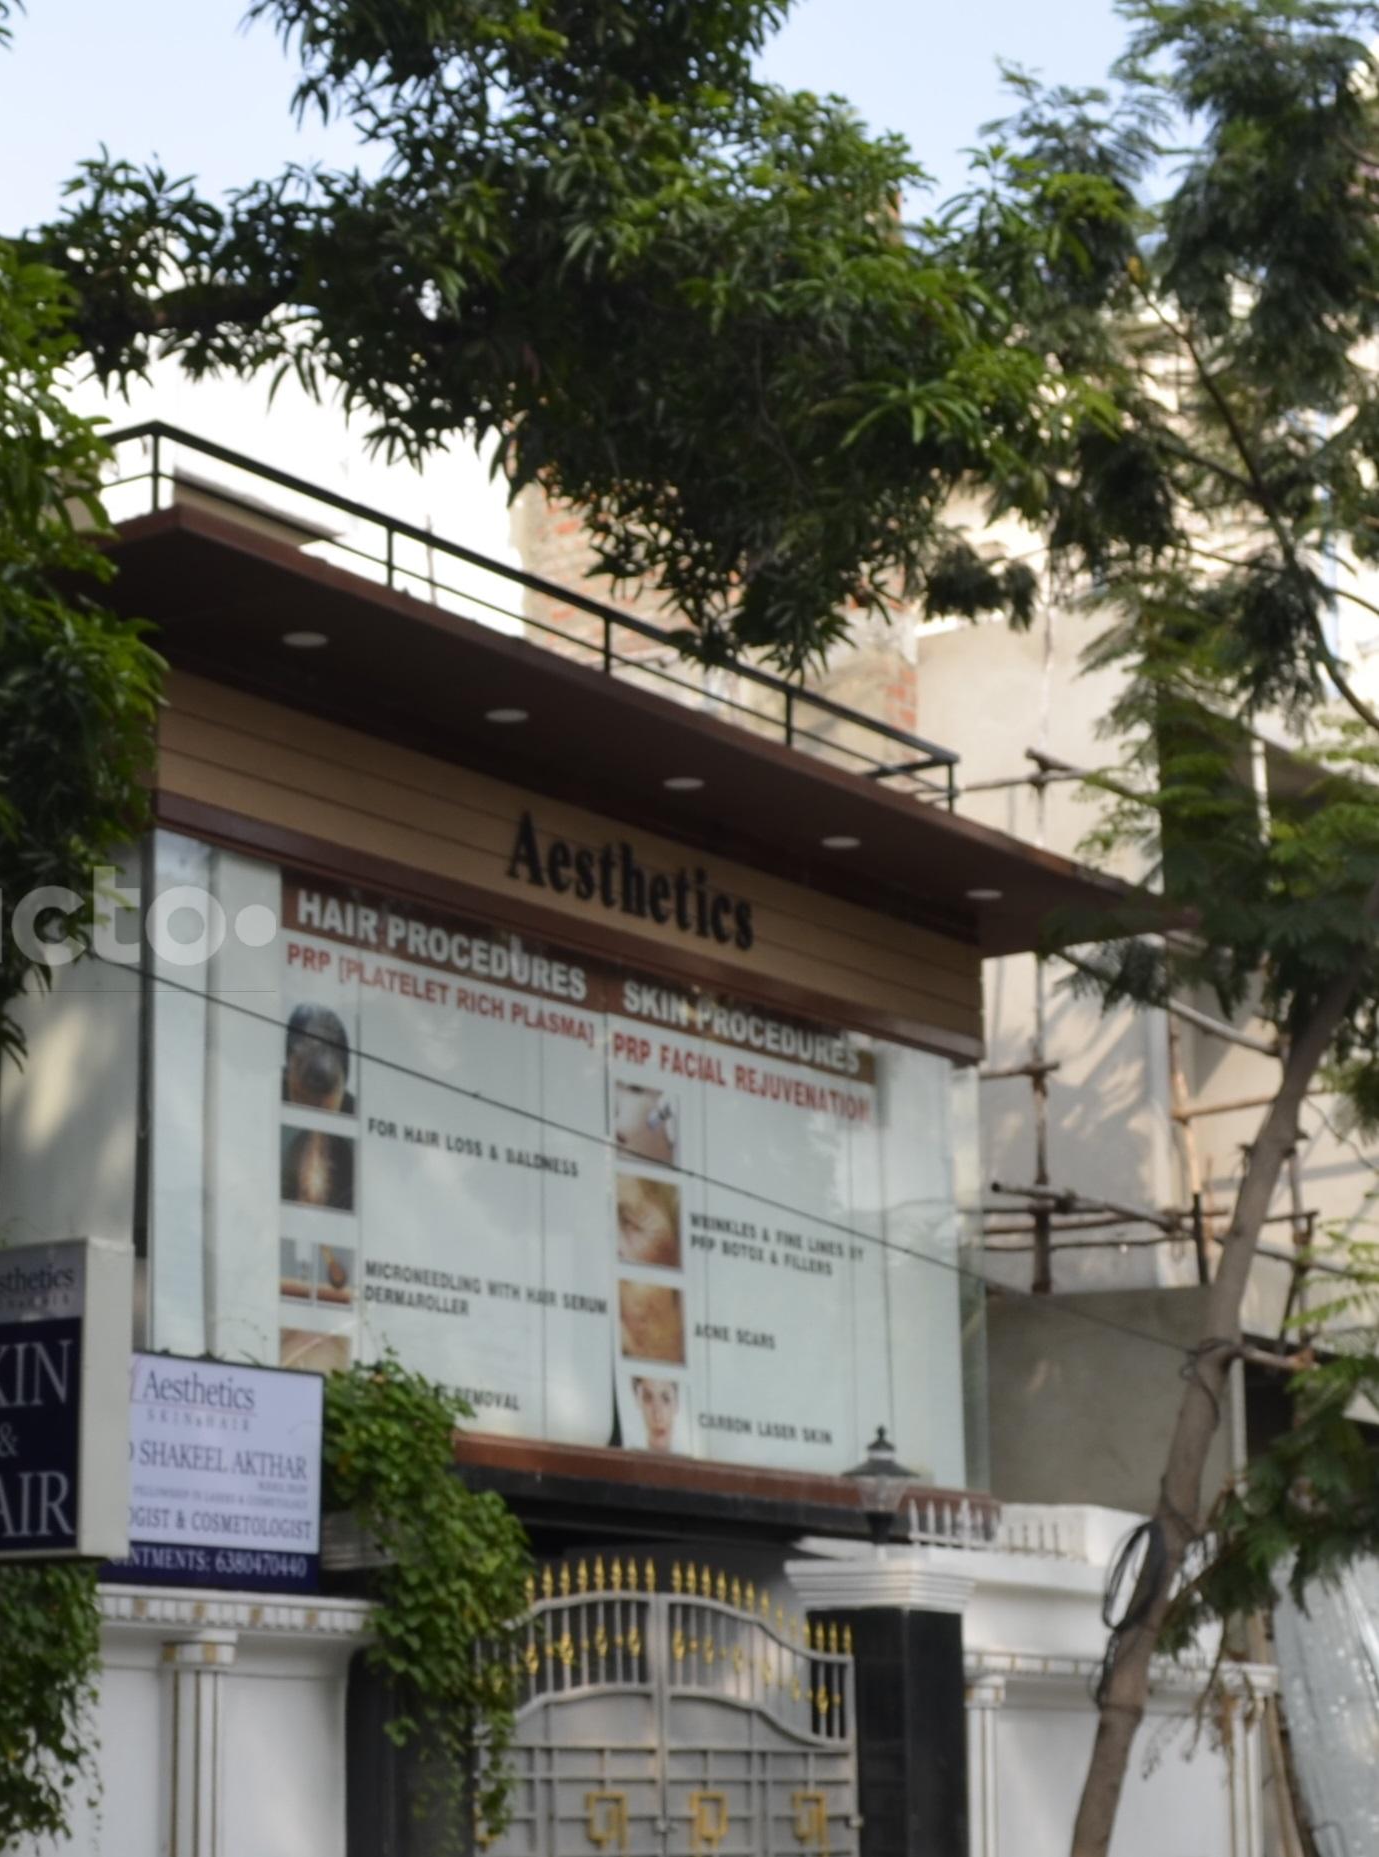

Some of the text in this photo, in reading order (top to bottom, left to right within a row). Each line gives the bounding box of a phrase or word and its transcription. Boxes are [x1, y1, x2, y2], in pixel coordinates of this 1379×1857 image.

[506, 809, 755, 951] Aesthetics
[296, 888, 588, 1002] HAIR PROCEDURES
[287, 942, 331, 974] PRP
[457, 987, 505, 1024] RICH
[623, 978, 861, 1075] SKIN PROCEDURES
[612, 1031, 871, 1122] PRP FACIAL REJUVENATION
[368, 1117, 579, 1178] FOR HAIR LOSS & BALDNESS
[690, 1212, 757, 1240] WRINKLES
[808, 1237, 844, 1259] LINES
[784, 1252, 833, 1277] FILLERS
[364, 1284, 470, 1317] DERMAROLLER
[365, 1260, 608, 1315] MICRONEEDLING WITH HAIR SERUM
[695, 1322, 776, 1351] ACNE SCARS
[143, 1369, 256, 1410] Aesthetics
[698, 1412, 833, 1445] CARBON LASER SKIN
[139, 1438, 228, 1474] SHAKEEL
[231, 1450, 308, 1481] AKTHAR
[175, 1509, 186, 1530] &
[191, 1510, 313, 1541] COSMETOLOGIST
[214, 1553, 308, 1578] 6380470440
